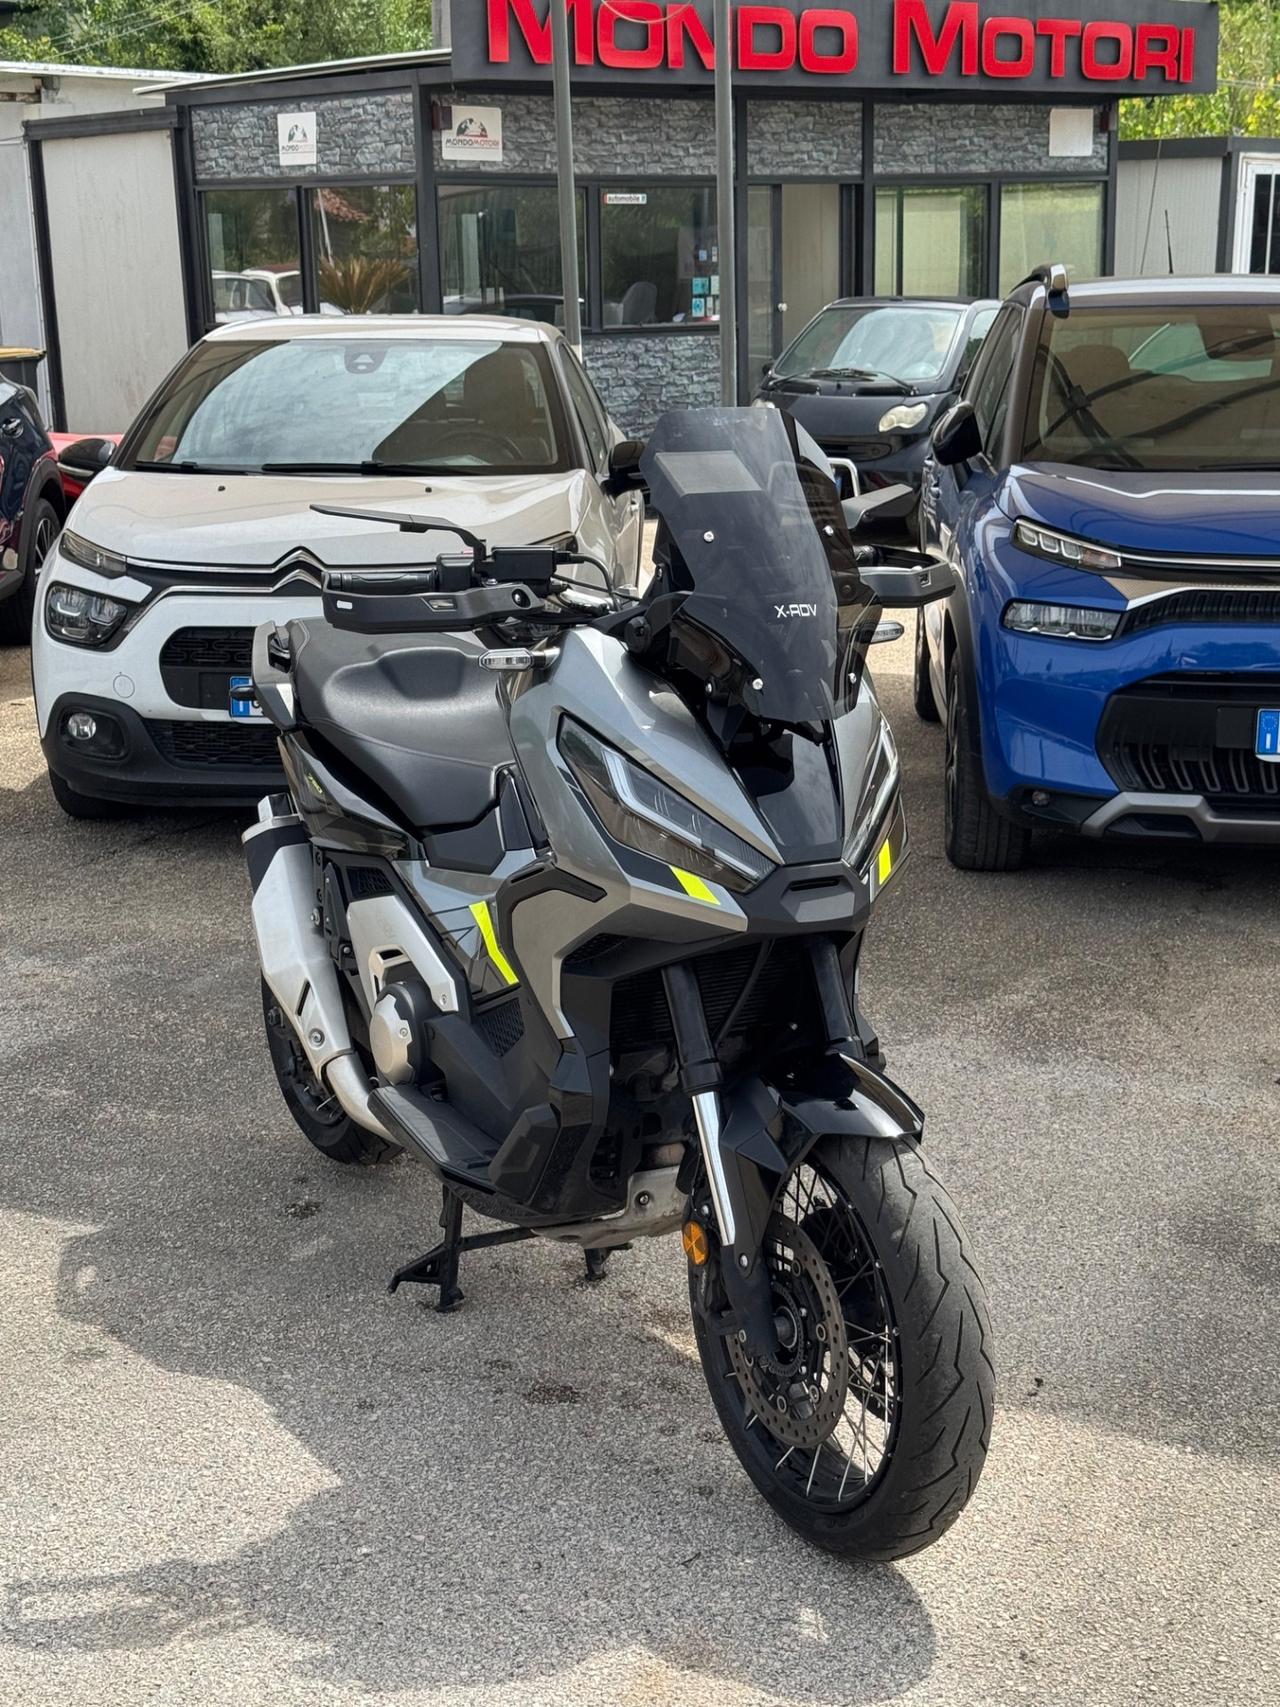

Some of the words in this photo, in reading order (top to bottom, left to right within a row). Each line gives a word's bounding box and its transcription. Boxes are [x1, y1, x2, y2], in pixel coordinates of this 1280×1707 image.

[487, 0, 858, 75] MONDO
[893, 0, 1196, 83] MOTORI
[774, 603, 817, 618] X-ADV
